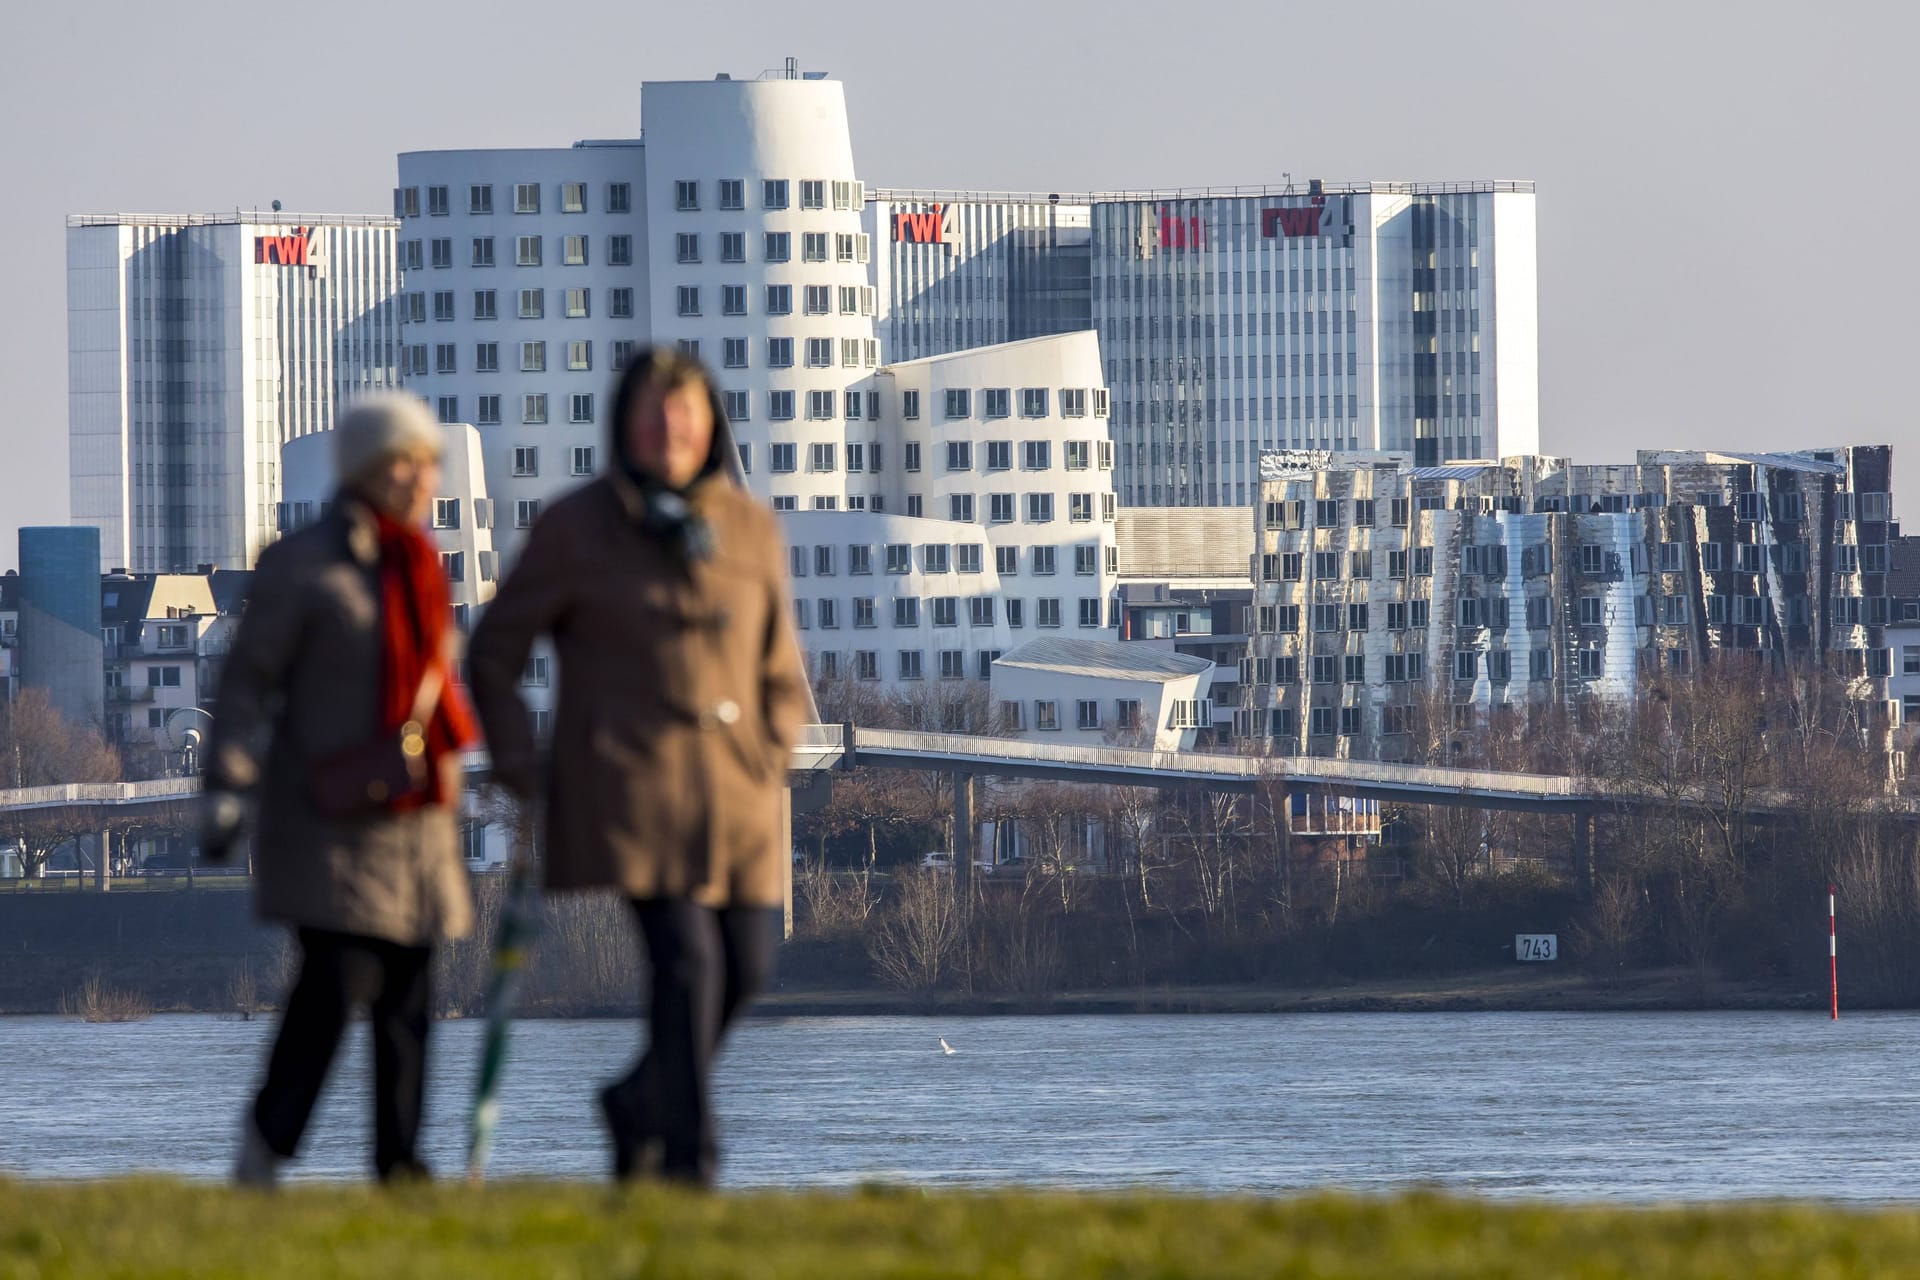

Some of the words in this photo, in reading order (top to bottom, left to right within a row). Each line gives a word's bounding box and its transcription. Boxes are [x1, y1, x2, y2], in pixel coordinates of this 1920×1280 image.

[897, 202, 963, 256] rwi4
[1262, 195, 1348, 248] rwi4
[262, 225, 328, 278] rwi4
[1523, 939, 1550, 959] 743
